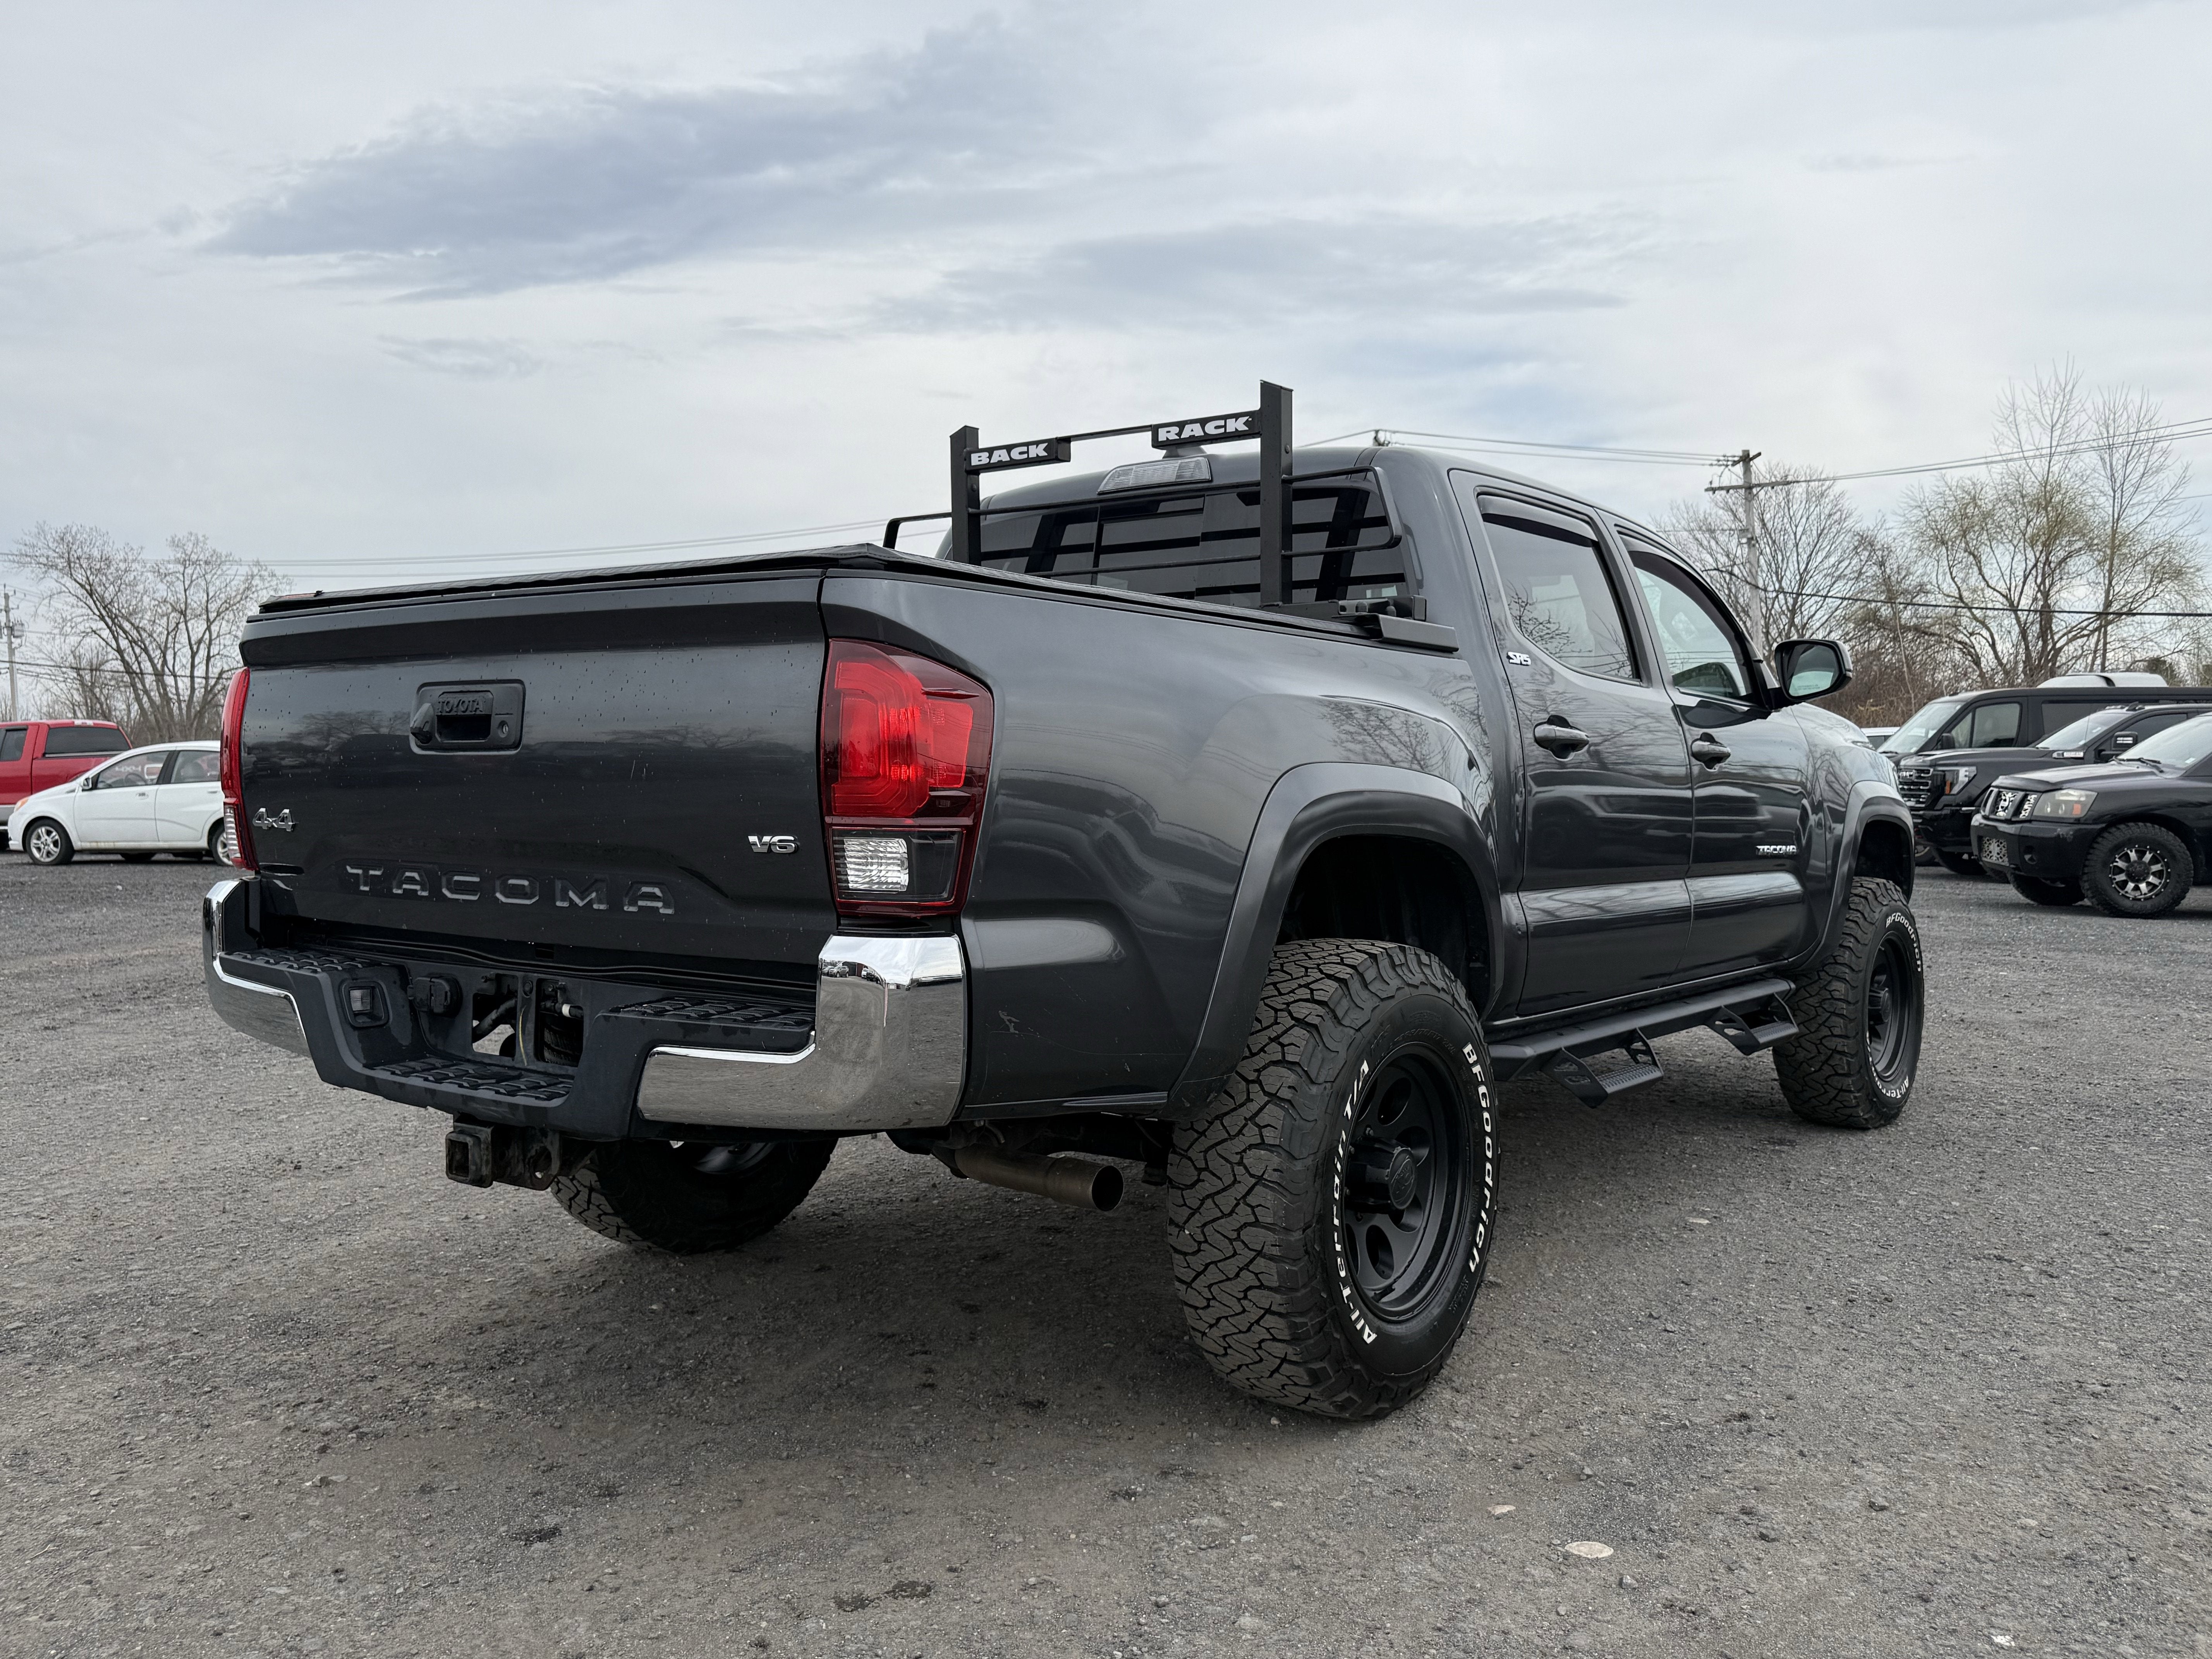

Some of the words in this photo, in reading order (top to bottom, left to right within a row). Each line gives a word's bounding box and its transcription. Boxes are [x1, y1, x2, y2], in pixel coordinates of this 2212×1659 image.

[971, 443, 1048, 465] BACK
[1158, 416, 1249, 441] RACK
[1508, 651, 1531, 666] SR5
[438, 699, 484, 714] TOYOTA
[748, 835, 795, 854] V6
[1756, 845, 1797, 855] TACOMA
[346, 864, 675, 914] TACOMA
[1462, 1042, 1493, 1273] BFGoodrich
